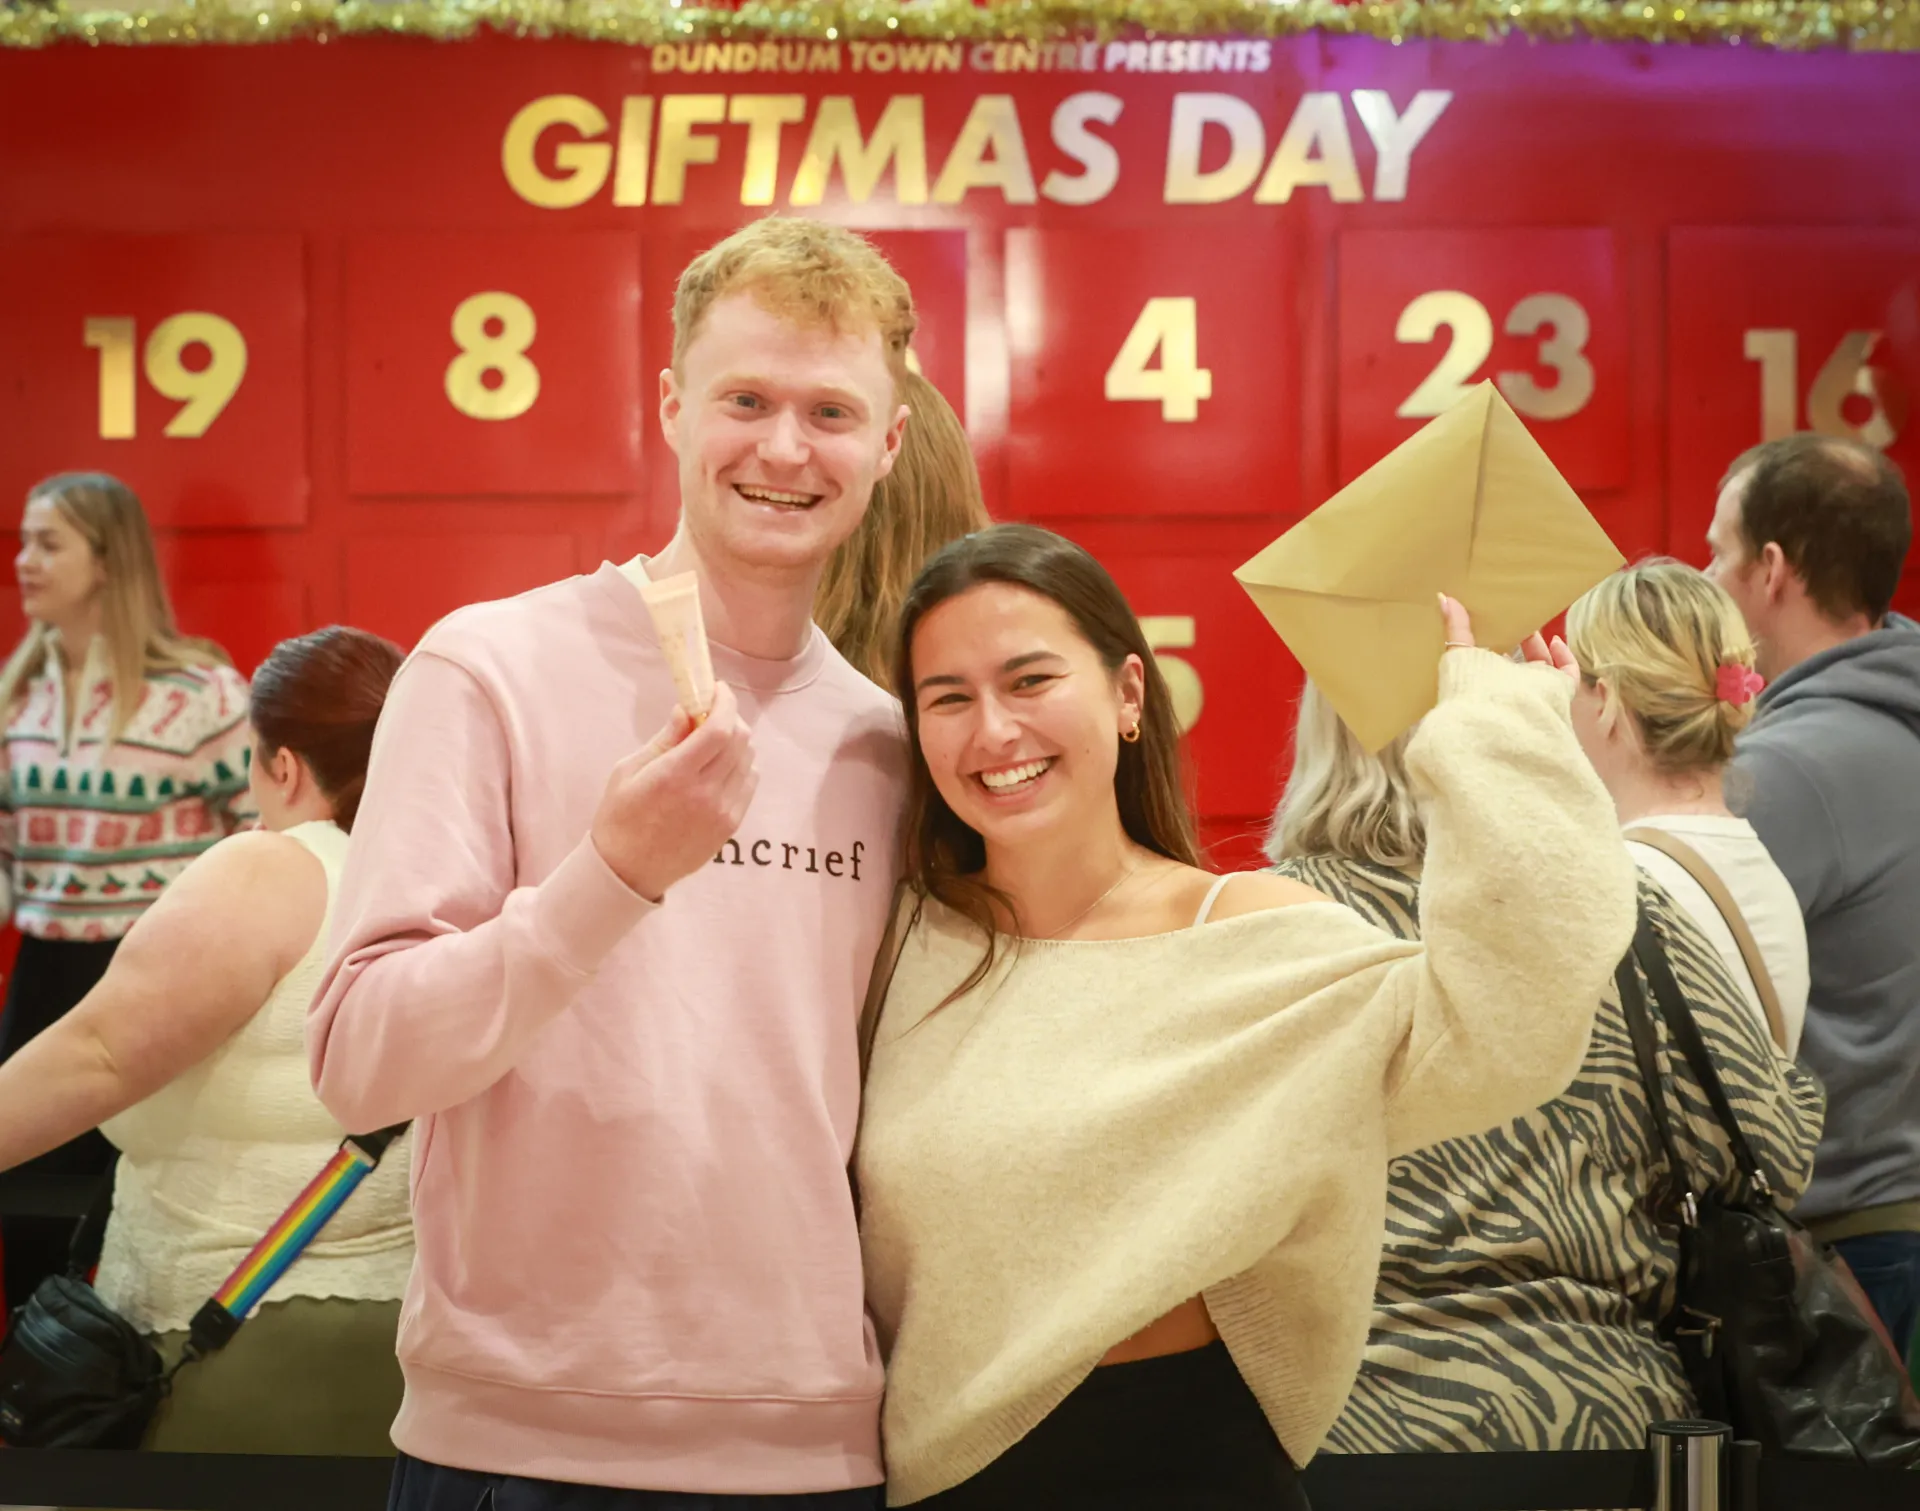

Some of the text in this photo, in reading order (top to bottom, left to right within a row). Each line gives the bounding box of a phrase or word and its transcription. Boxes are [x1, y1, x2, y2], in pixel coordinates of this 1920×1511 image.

[651, 40, 1272, 73] DUNDRUM TOWN CENTRE PRESENTS
[501, 89, 1454, 208] GIFTMAS DAY
[83, 312, 248, 440] 19
[444, 291, 541, 421] 8
[1104, 296, 1213, 423] 4
[1395, 289, 1595, 421] 23
[1743, 328, 1906, 450] 16
[713, 837, 866, 882] ncrief
